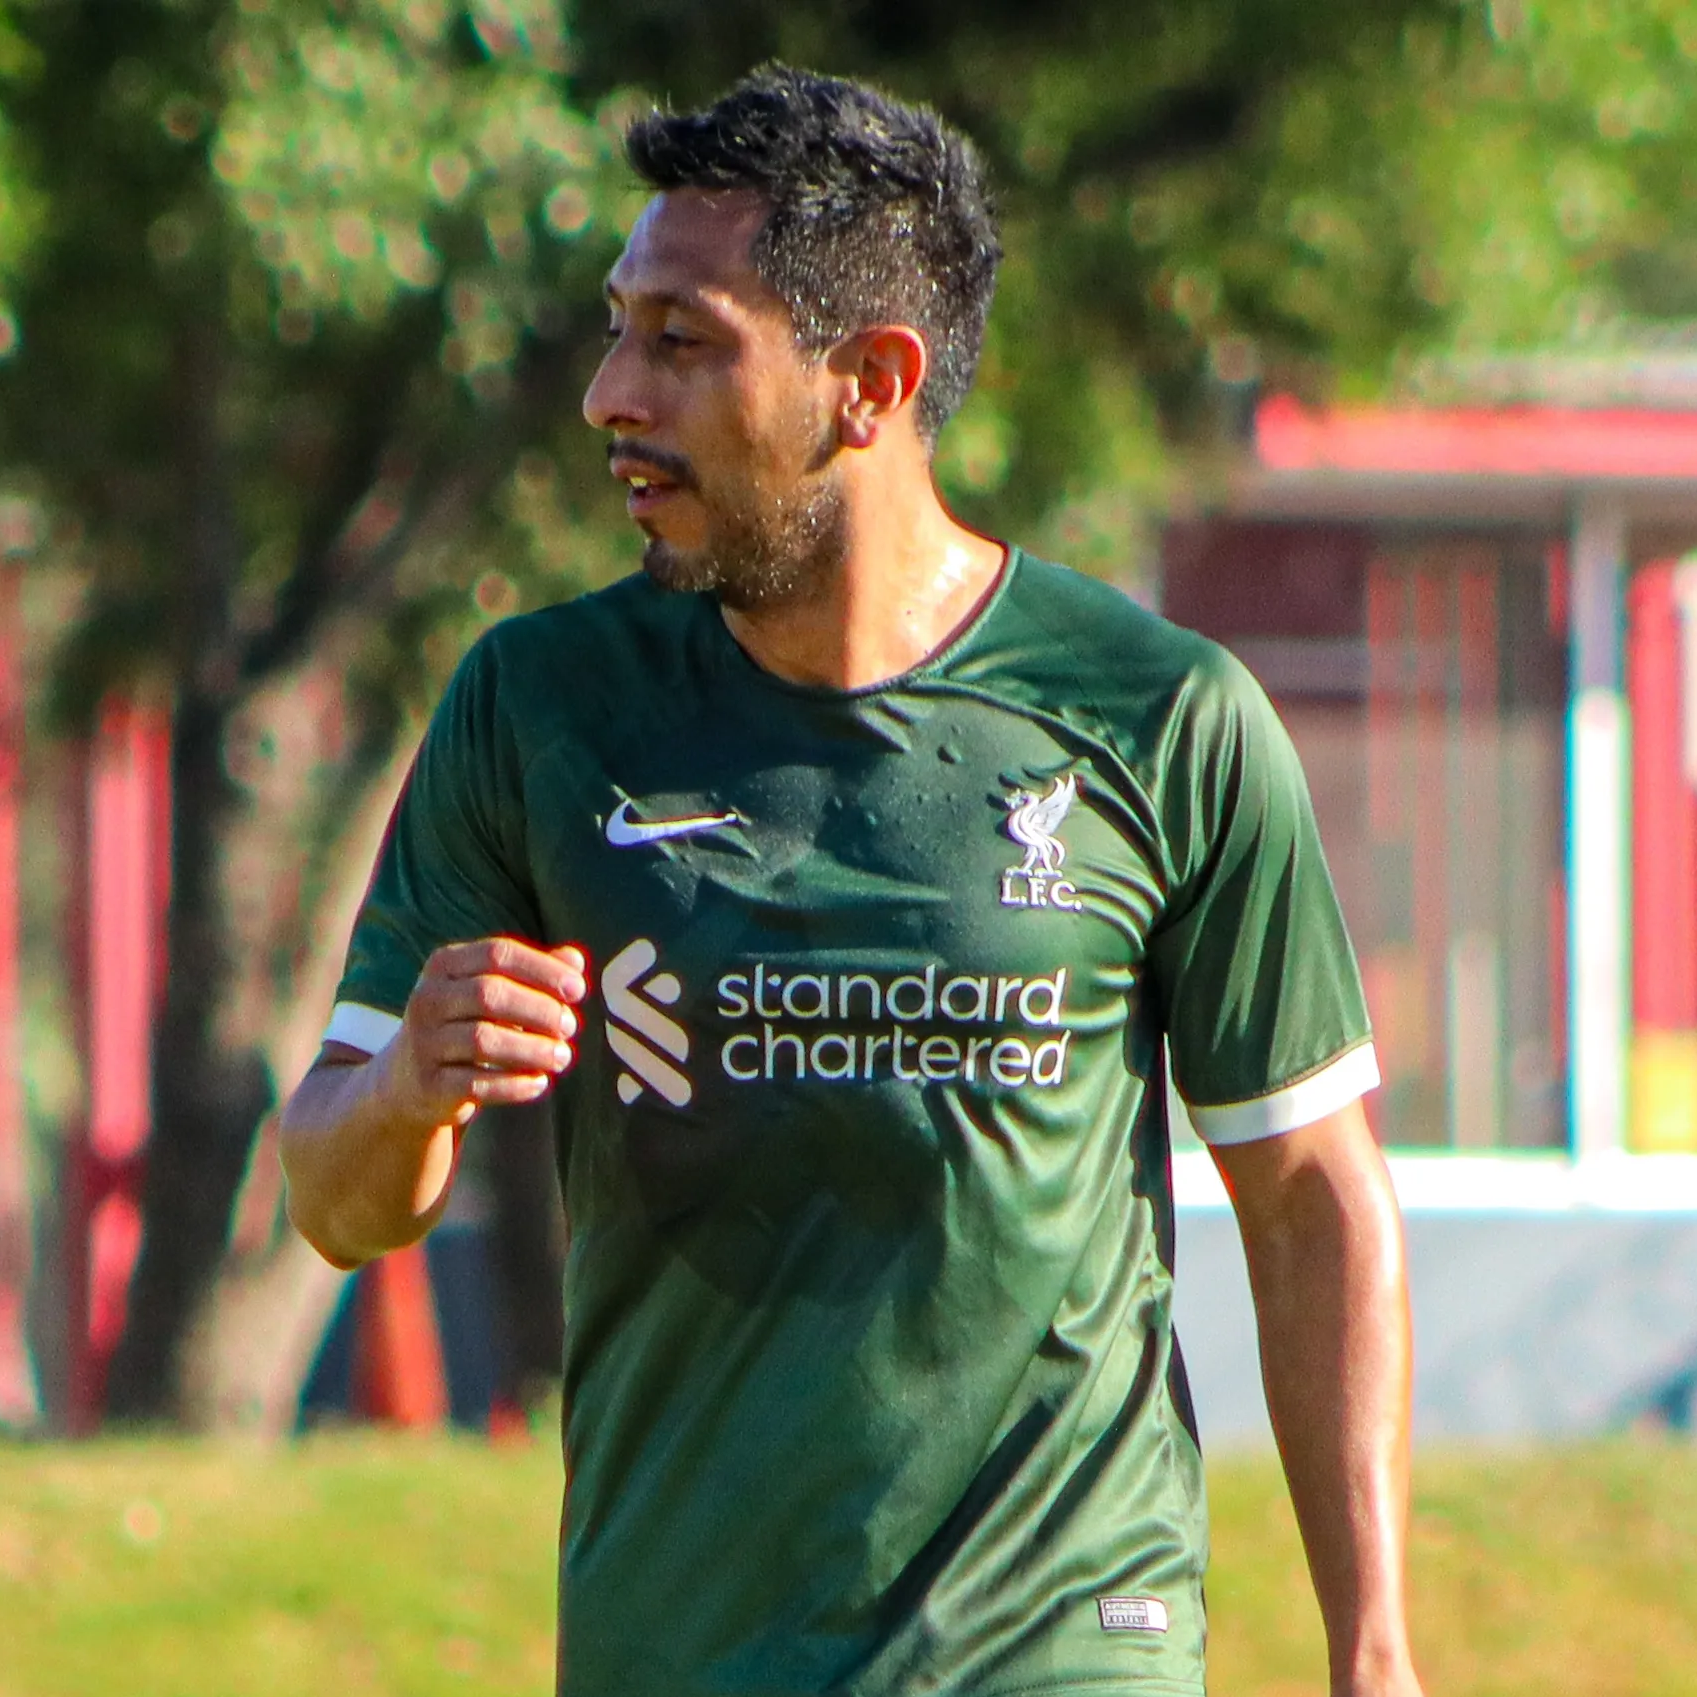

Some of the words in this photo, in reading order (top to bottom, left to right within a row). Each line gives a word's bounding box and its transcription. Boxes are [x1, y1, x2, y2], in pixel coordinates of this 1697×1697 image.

[1001, 877, 1082, 911] L.F.C.
[717, 963, 1066, 1026] standard
[721, 1023, 1071, 1087] chartered
